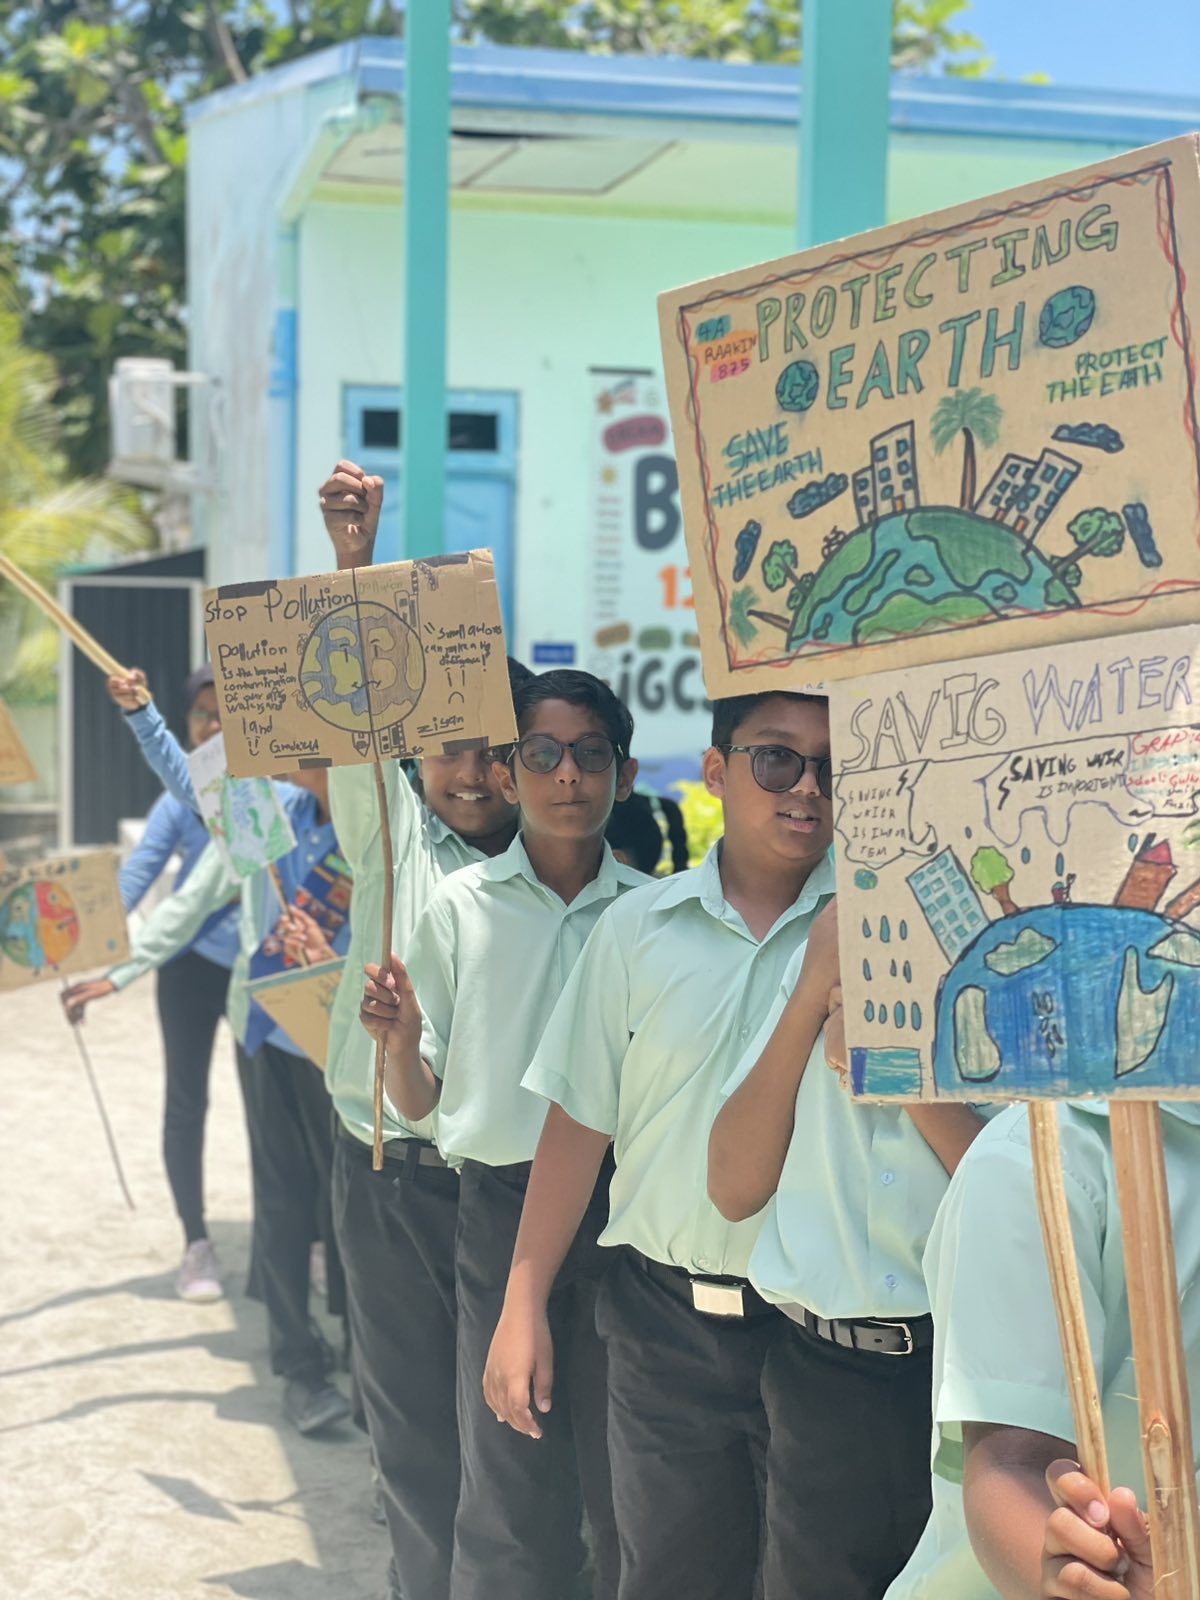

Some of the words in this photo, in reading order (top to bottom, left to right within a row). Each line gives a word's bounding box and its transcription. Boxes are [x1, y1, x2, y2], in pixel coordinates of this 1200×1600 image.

[756, 204, 1119, 363] PROTECTING
[718, 358, 750, 379] 875
[825, 301, 1026, 410] EARTH
[1075, 335, 1168, 376] PROTECT
[1046, 376, 1092, 404] THE
[726, 420, 788, 477] SAVE
[205, 600, 248, 624] Stop
[263, 584, 354, 622] Pollution
[242, 715, 273, 736] land
[840, 673, 1007, 773] SAVIG
[1022, 656, 1193, 735] WATER
[1009, 753, 1077, 783] SAVING
[1035, 784, 1054, 799] IS
